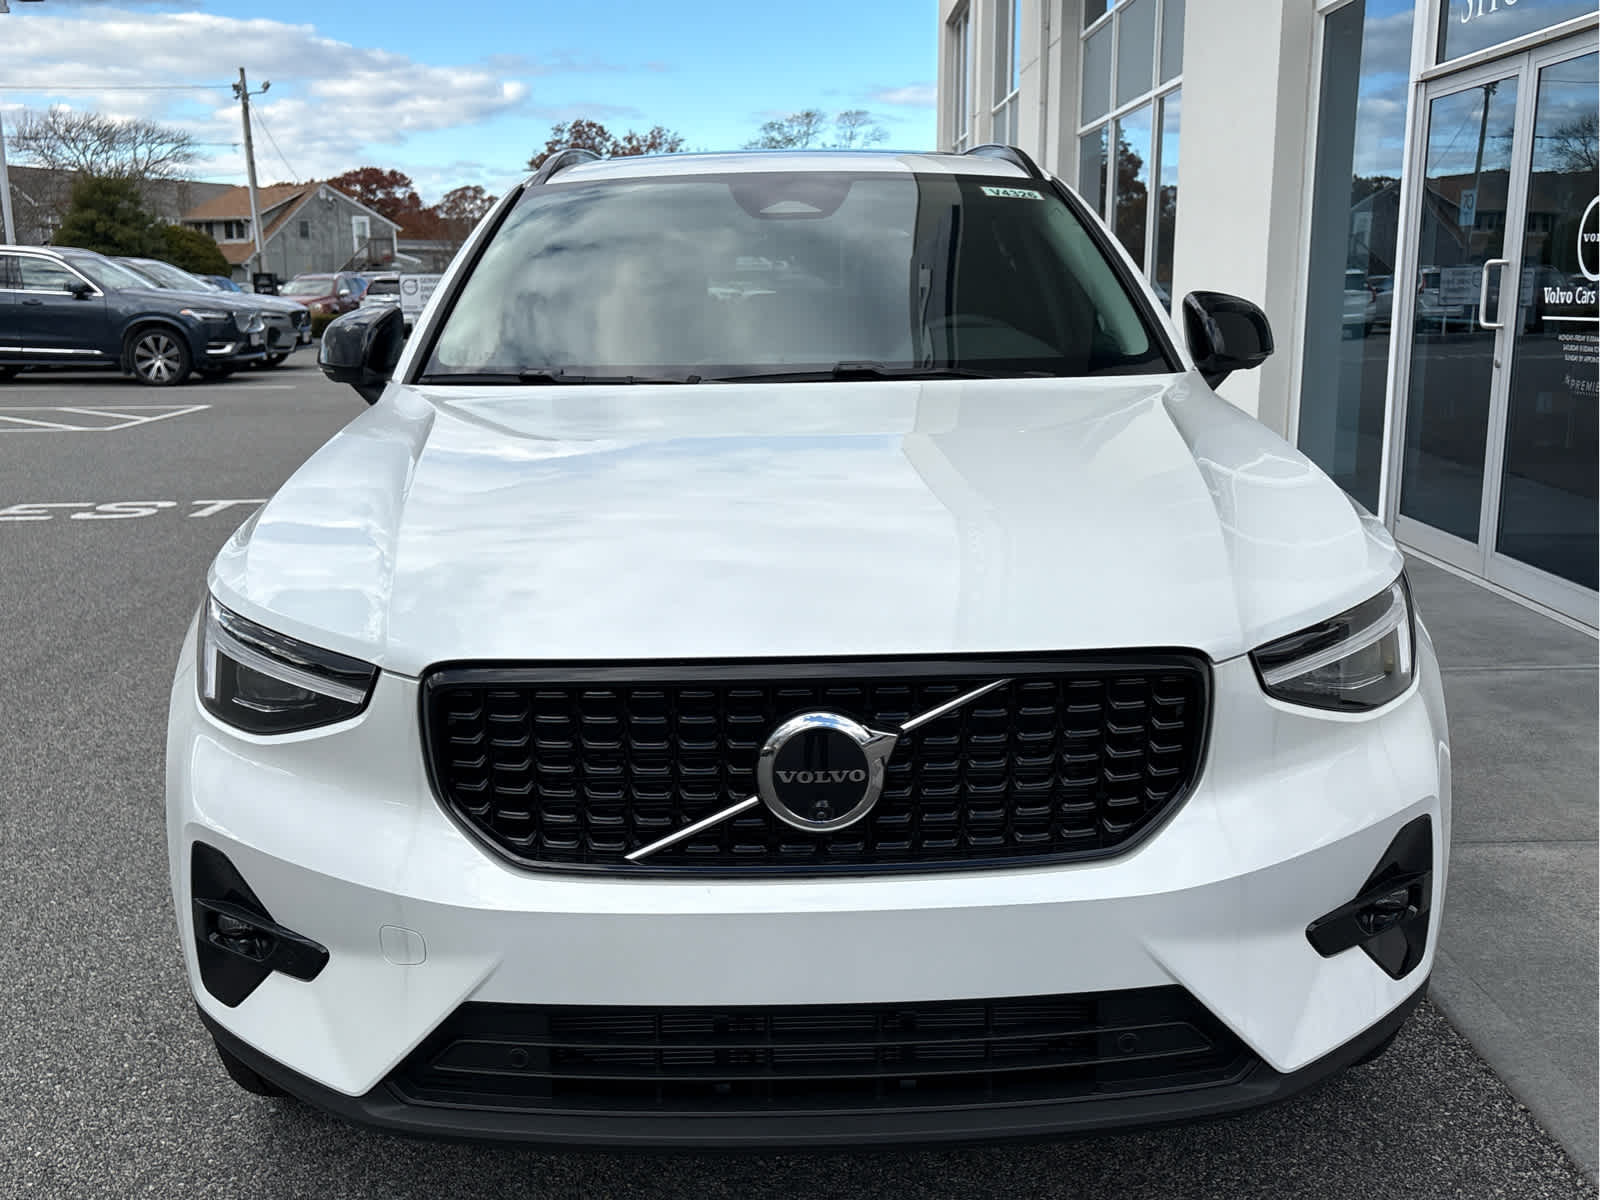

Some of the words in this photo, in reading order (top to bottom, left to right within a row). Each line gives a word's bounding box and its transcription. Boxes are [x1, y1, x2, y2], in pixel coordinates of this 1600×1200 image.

[1543, 287, 1573, 304] Volvo
[1575, 286, 1596, 304] Cars
[776, 769, 866, 784] VOLVO
